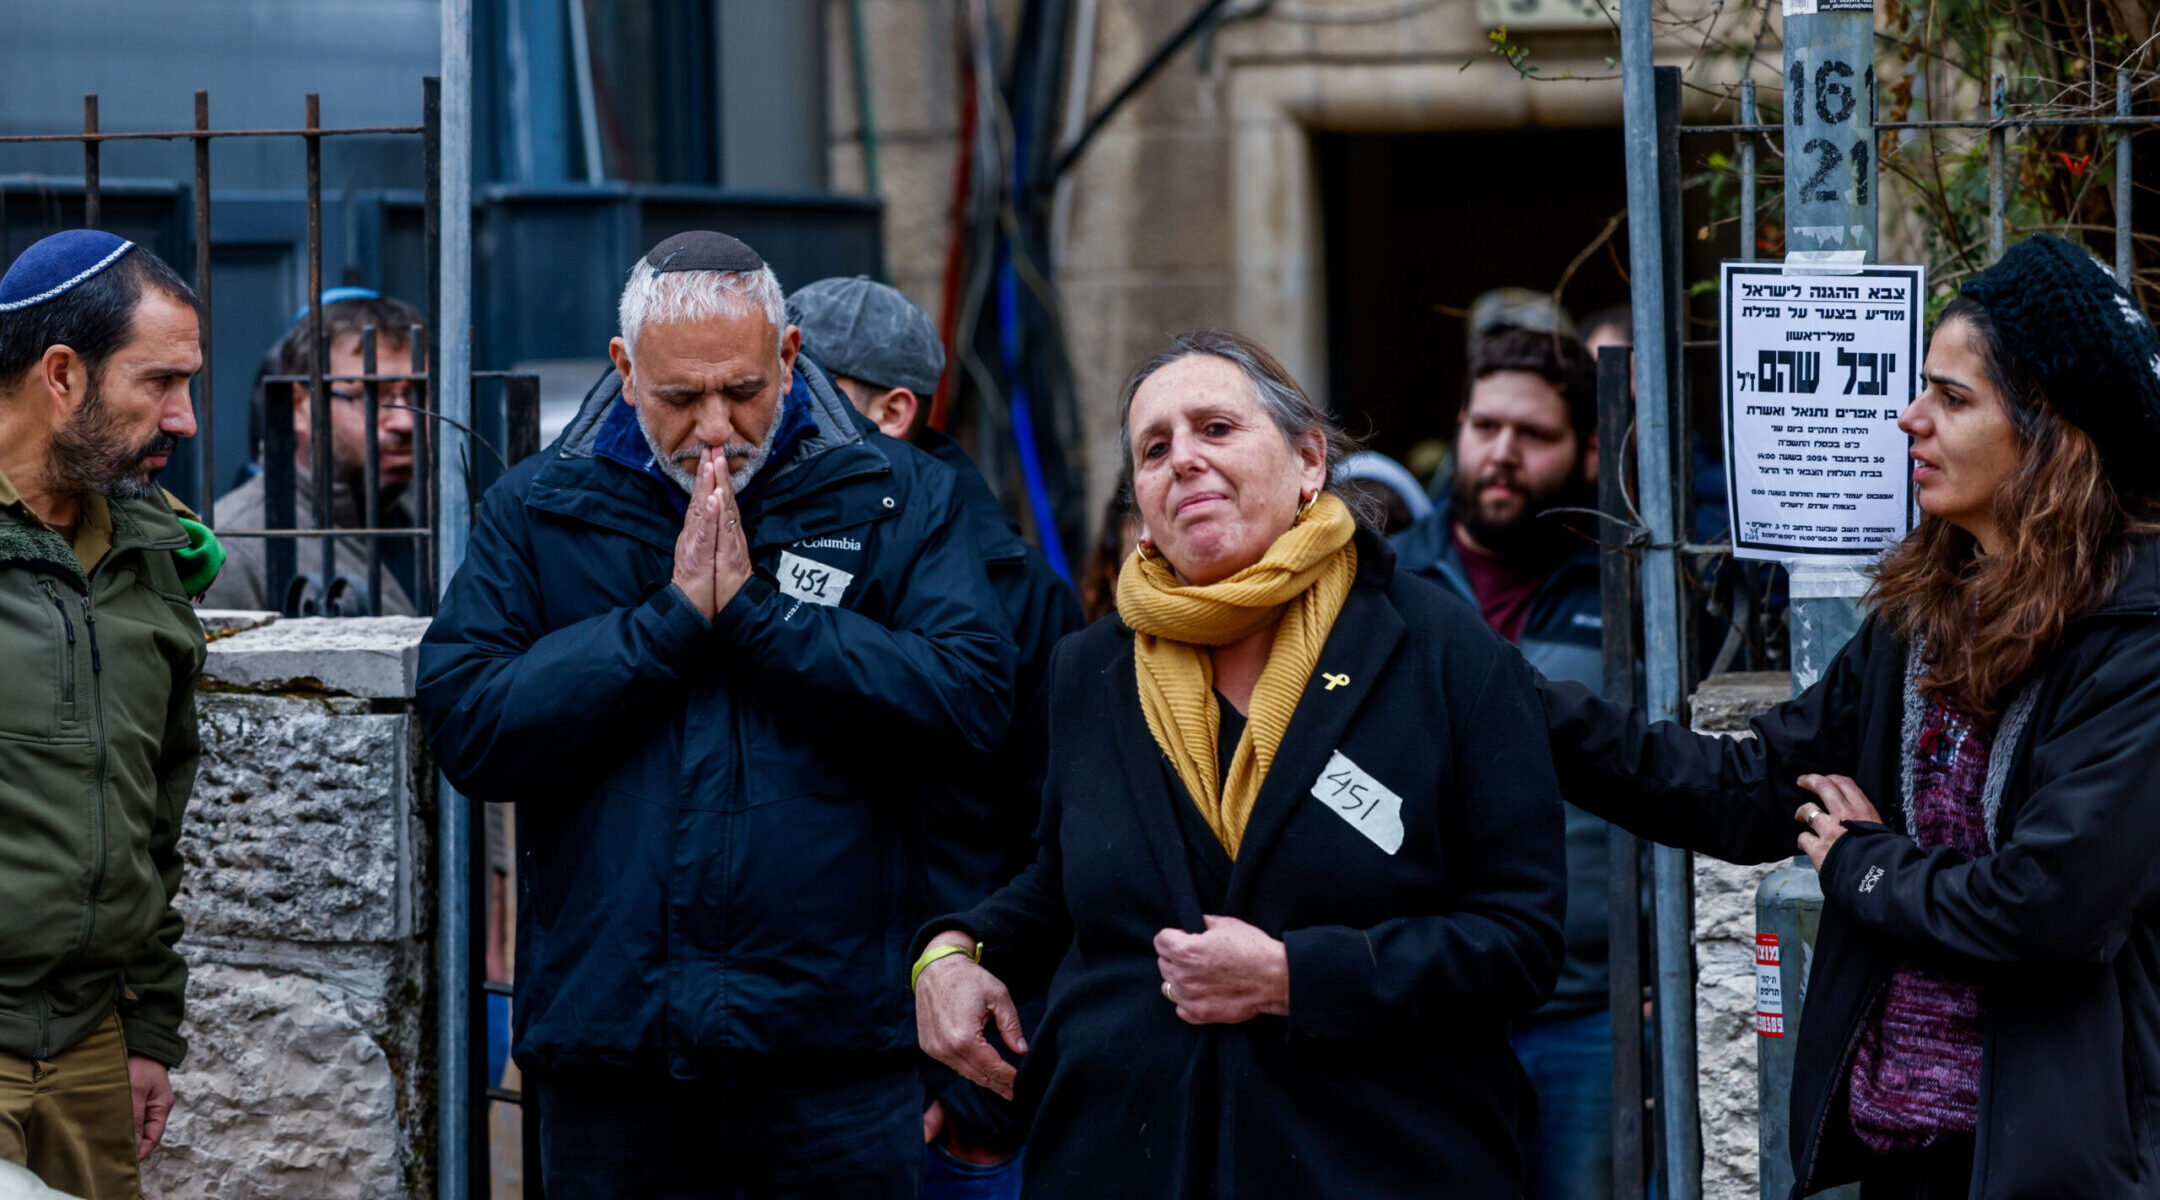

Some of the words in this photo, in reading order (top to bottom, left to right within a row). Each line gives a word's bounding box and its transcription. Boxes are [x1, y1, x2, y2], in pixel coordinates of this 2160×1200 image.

[1800, 138, 1869, 205] 21
[1742, 283, 1801, 297] לישראל
[1810, 286, 1859, 299] ההגנה
[1868, 287, 1905, 300] צבא
[1742, 305, 1780, 318] נפילת
[1788, 306, 1807, 318] על
[1815, 308, 1857, 320] בצער
[1865, 309, 1905, 321] מודיע
[1758, 350, 1820, 394] שהם
[1837, 347, 1896, 395] יובל
[1746, 405, 1785, 416] ואשרת
[1791, 406, 1829, 417] נתנאל
[1835, 408, 1877, 418] אפרים
[1884, 409, 1898, 420] בן
[1786, 425, 1804, 433] ביום
[1814, 440, 1840, 448] בכסלו
[1779, 453, 1803, 461] בשעה
[1806, 454, 1828, 462] 2024
[1832, 455, 1869, 463] בדצמבר
[1758, 466, 1780, 474] הרצל
[1783, 467, 1794, 475] הר
[1797, 468, 1823, 476] הצבאי
[1860, 470, 1883, 478] בבית
[802, 537, 861, 551] Columbia
[791, 563, 830, 598] 451
[1327, 770, 1380, 820] 451
